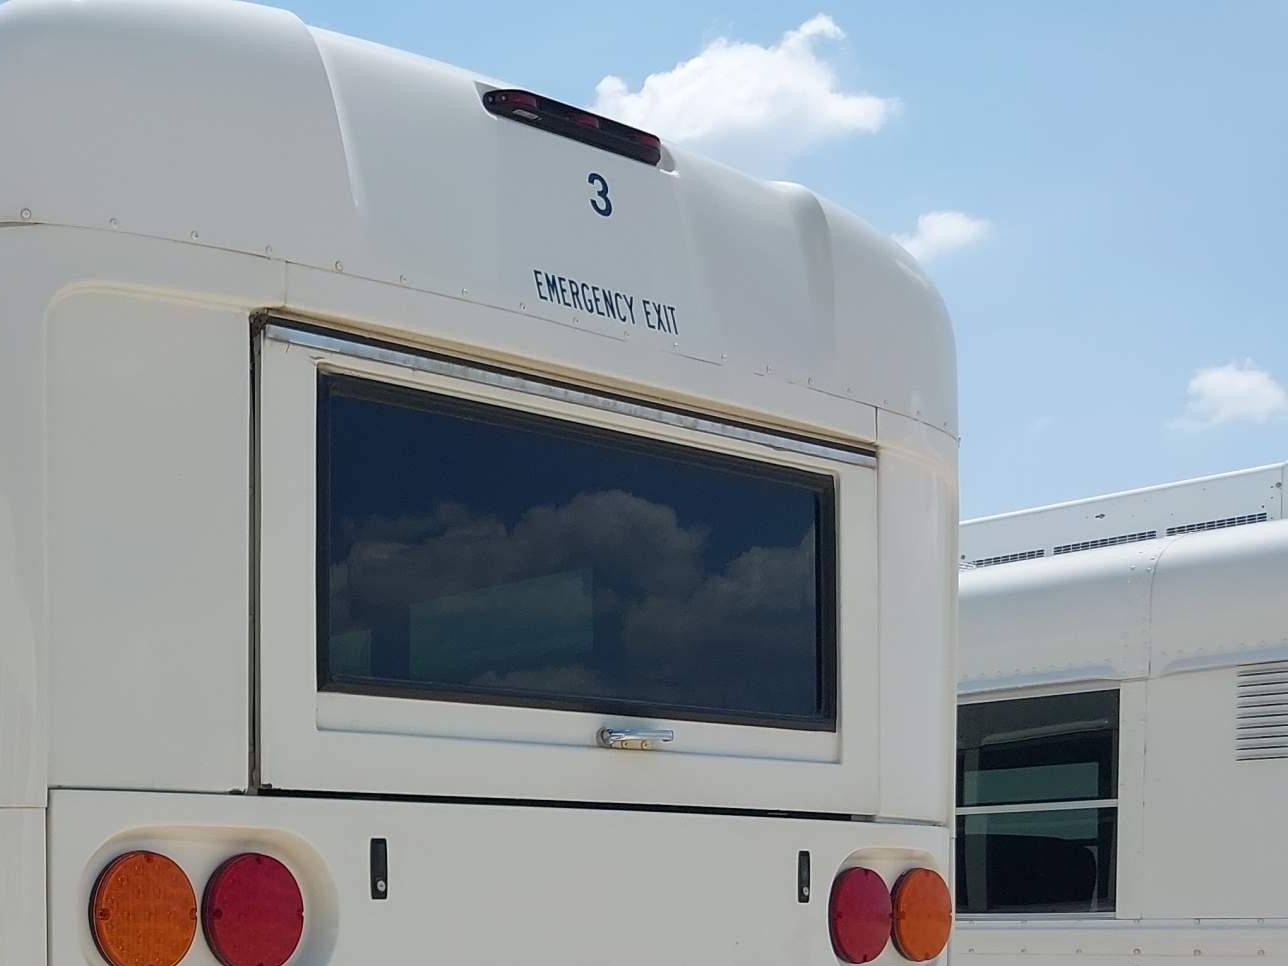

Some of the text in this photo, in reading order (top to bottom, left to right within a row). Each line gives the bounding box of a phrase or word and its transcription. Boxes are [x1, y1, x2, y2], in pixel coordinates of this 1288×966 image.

[587, 172, 613, 217] 3
[533, 269, 679, 335] EMERGENCY EXIT
